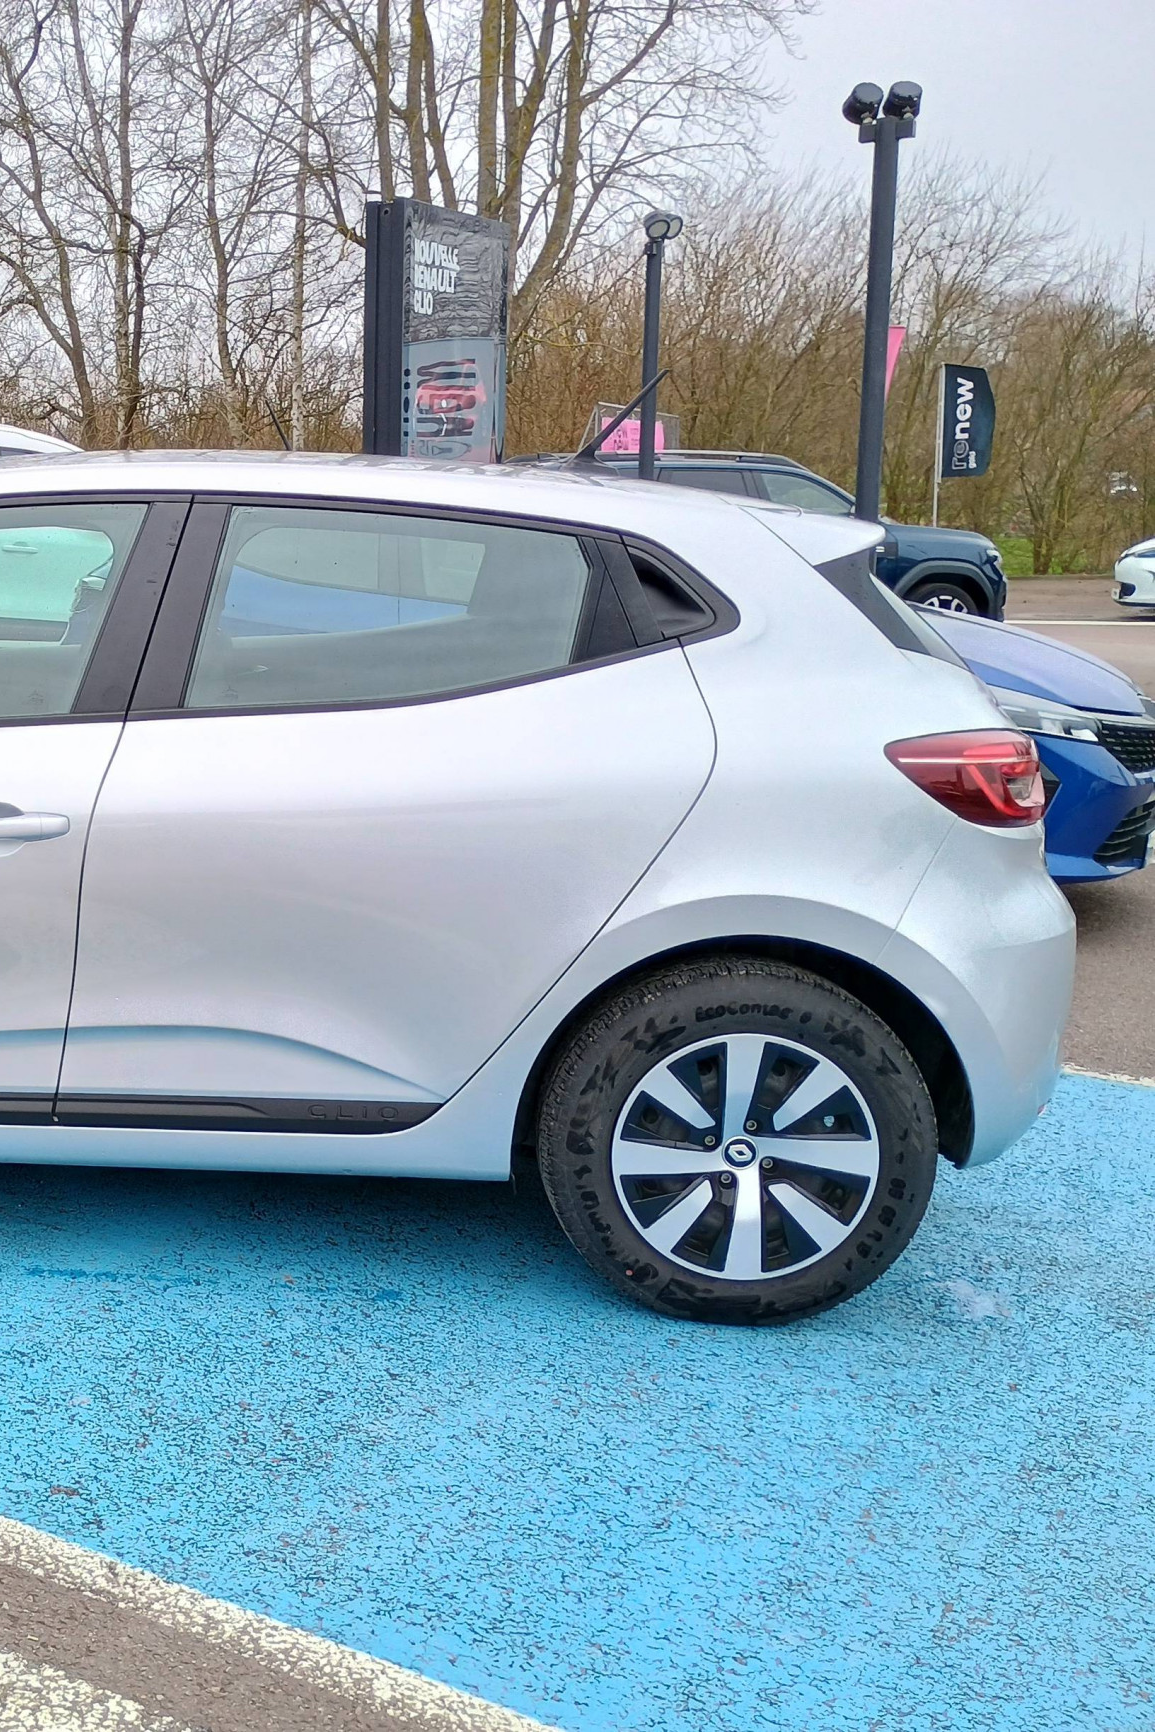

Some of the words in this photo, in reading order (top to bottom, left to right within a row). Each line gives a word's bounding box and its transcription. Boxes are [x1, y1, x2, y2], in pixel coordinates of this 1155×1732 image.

[415, 238, 460, 272] NOUVELLE
[414, 264, 457, 293] RENAULT
[414, 289, 433, 315] CLIO
[307, 1104, 399, 1121] CLIO
